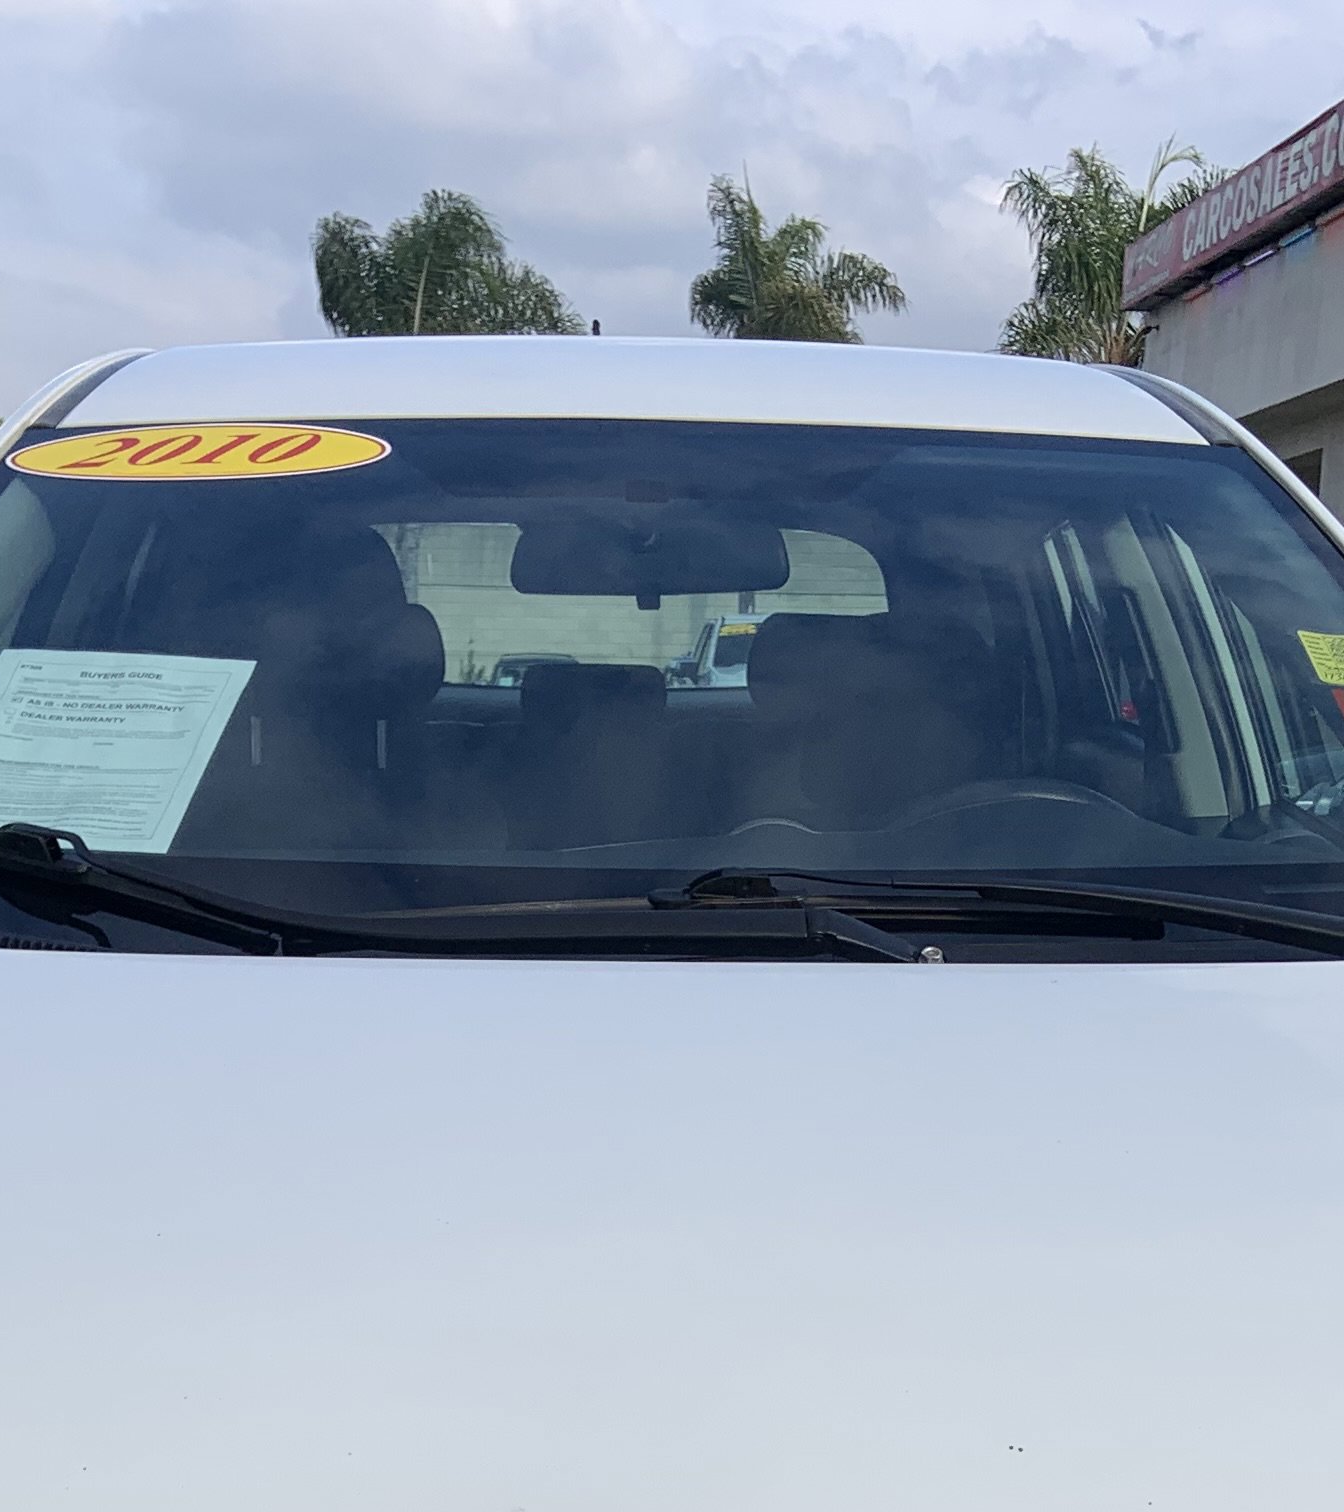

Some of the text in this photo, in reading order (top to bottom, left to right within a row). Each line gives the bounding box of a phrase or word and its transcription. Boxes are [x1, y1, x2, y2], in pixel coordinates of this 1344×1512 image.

[56, 433, 323, 470] 2010
[79, 670, 165, 682] BUYERS GUIDE
[80, 702, 124, 712] DEALER
[125, 702, 186, 713] WARRANTY
[19, 710, 127, 725] DEALER WARRANTY
